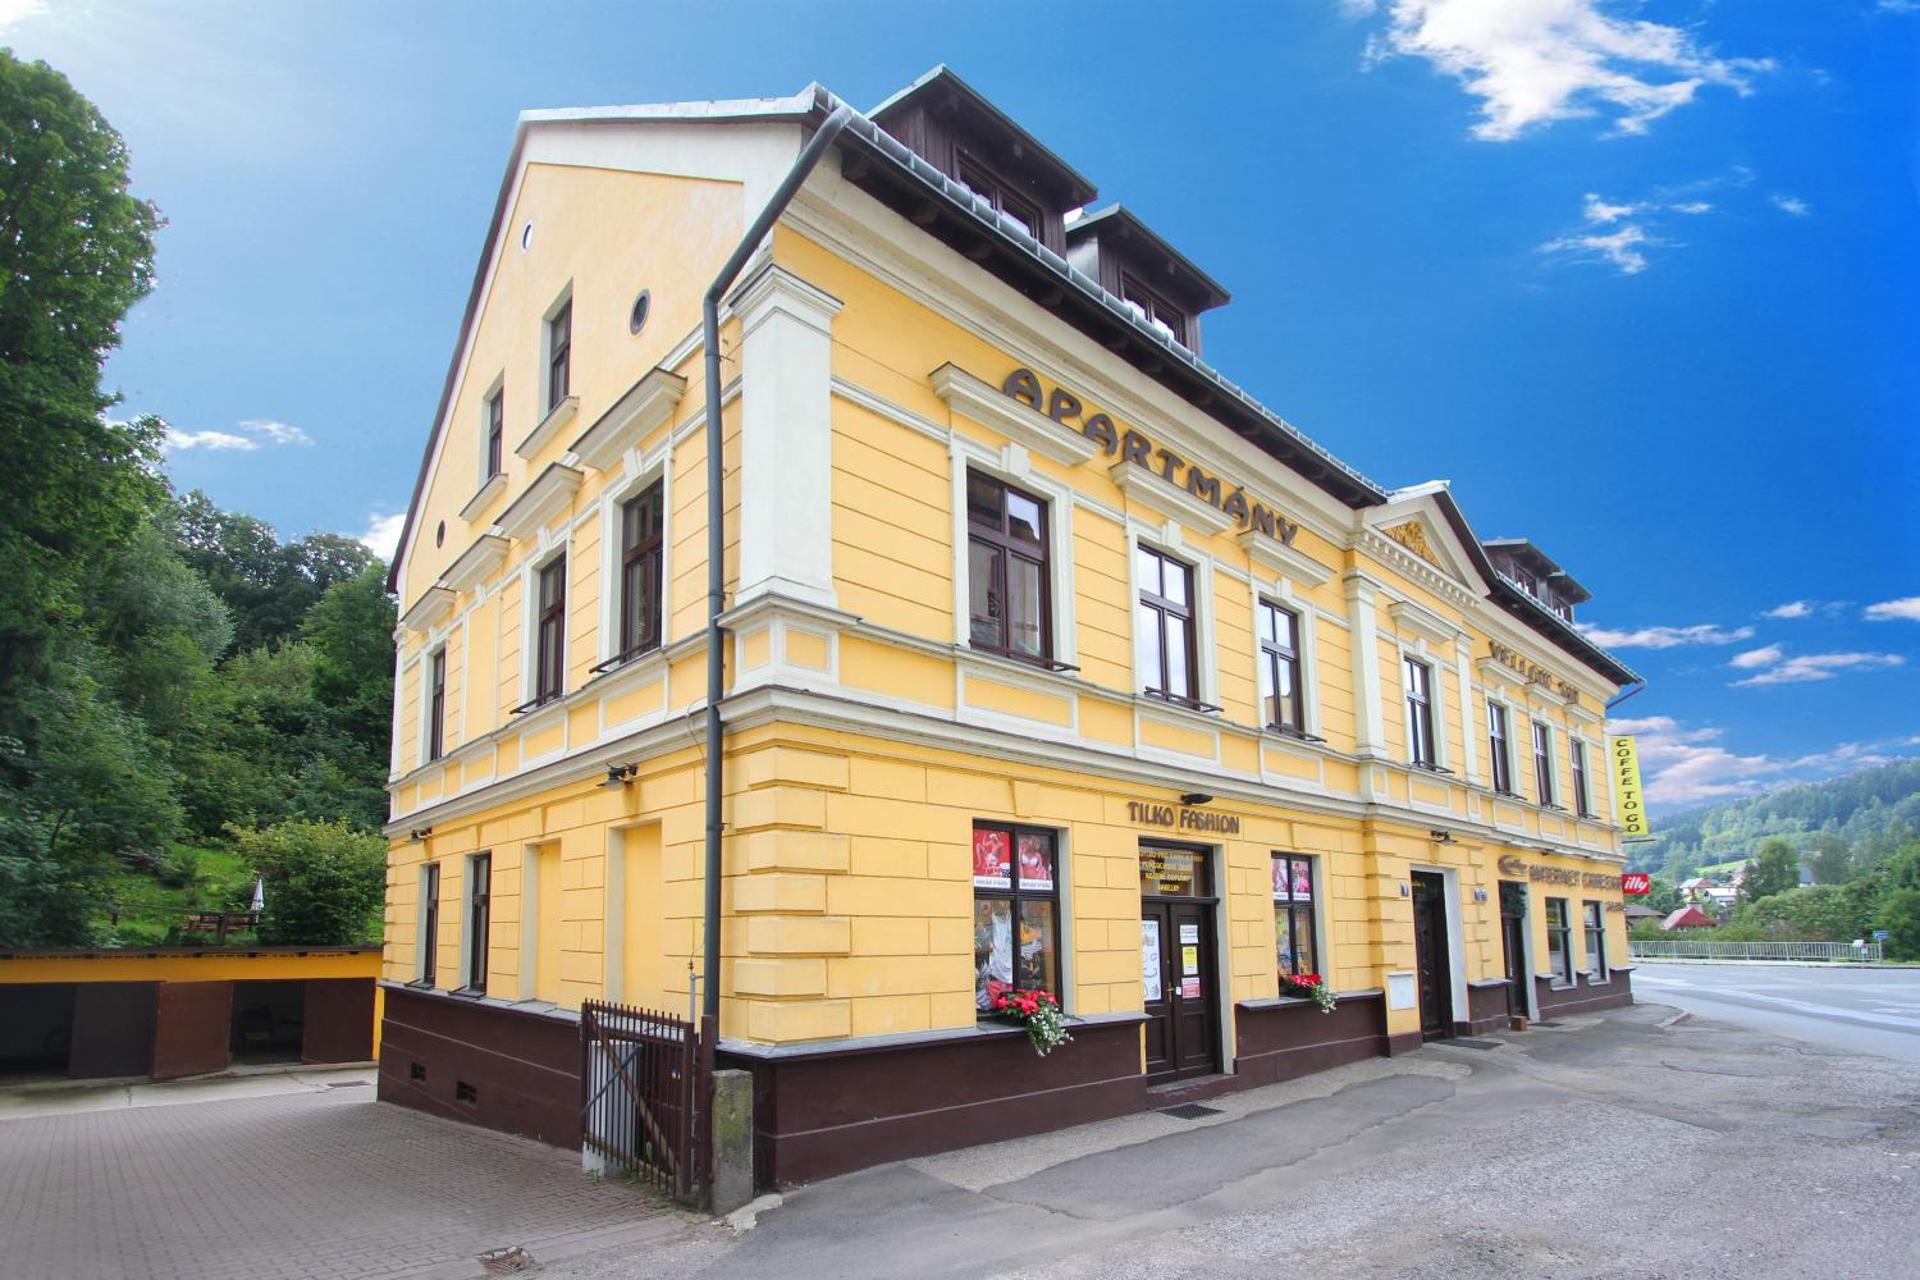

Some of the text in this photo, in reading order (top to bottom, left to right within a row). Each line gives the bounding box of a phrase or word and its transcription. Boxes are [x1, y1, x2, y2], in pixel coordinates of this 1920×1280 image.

[1003, 367, 1298, 547] APARTMÁNY
[1127, 801, 1240, 834] TILKO FASHION
[1616, 739, 1640, 833] COFFE TO GO
[1624, 876, 1648, 893] illy
